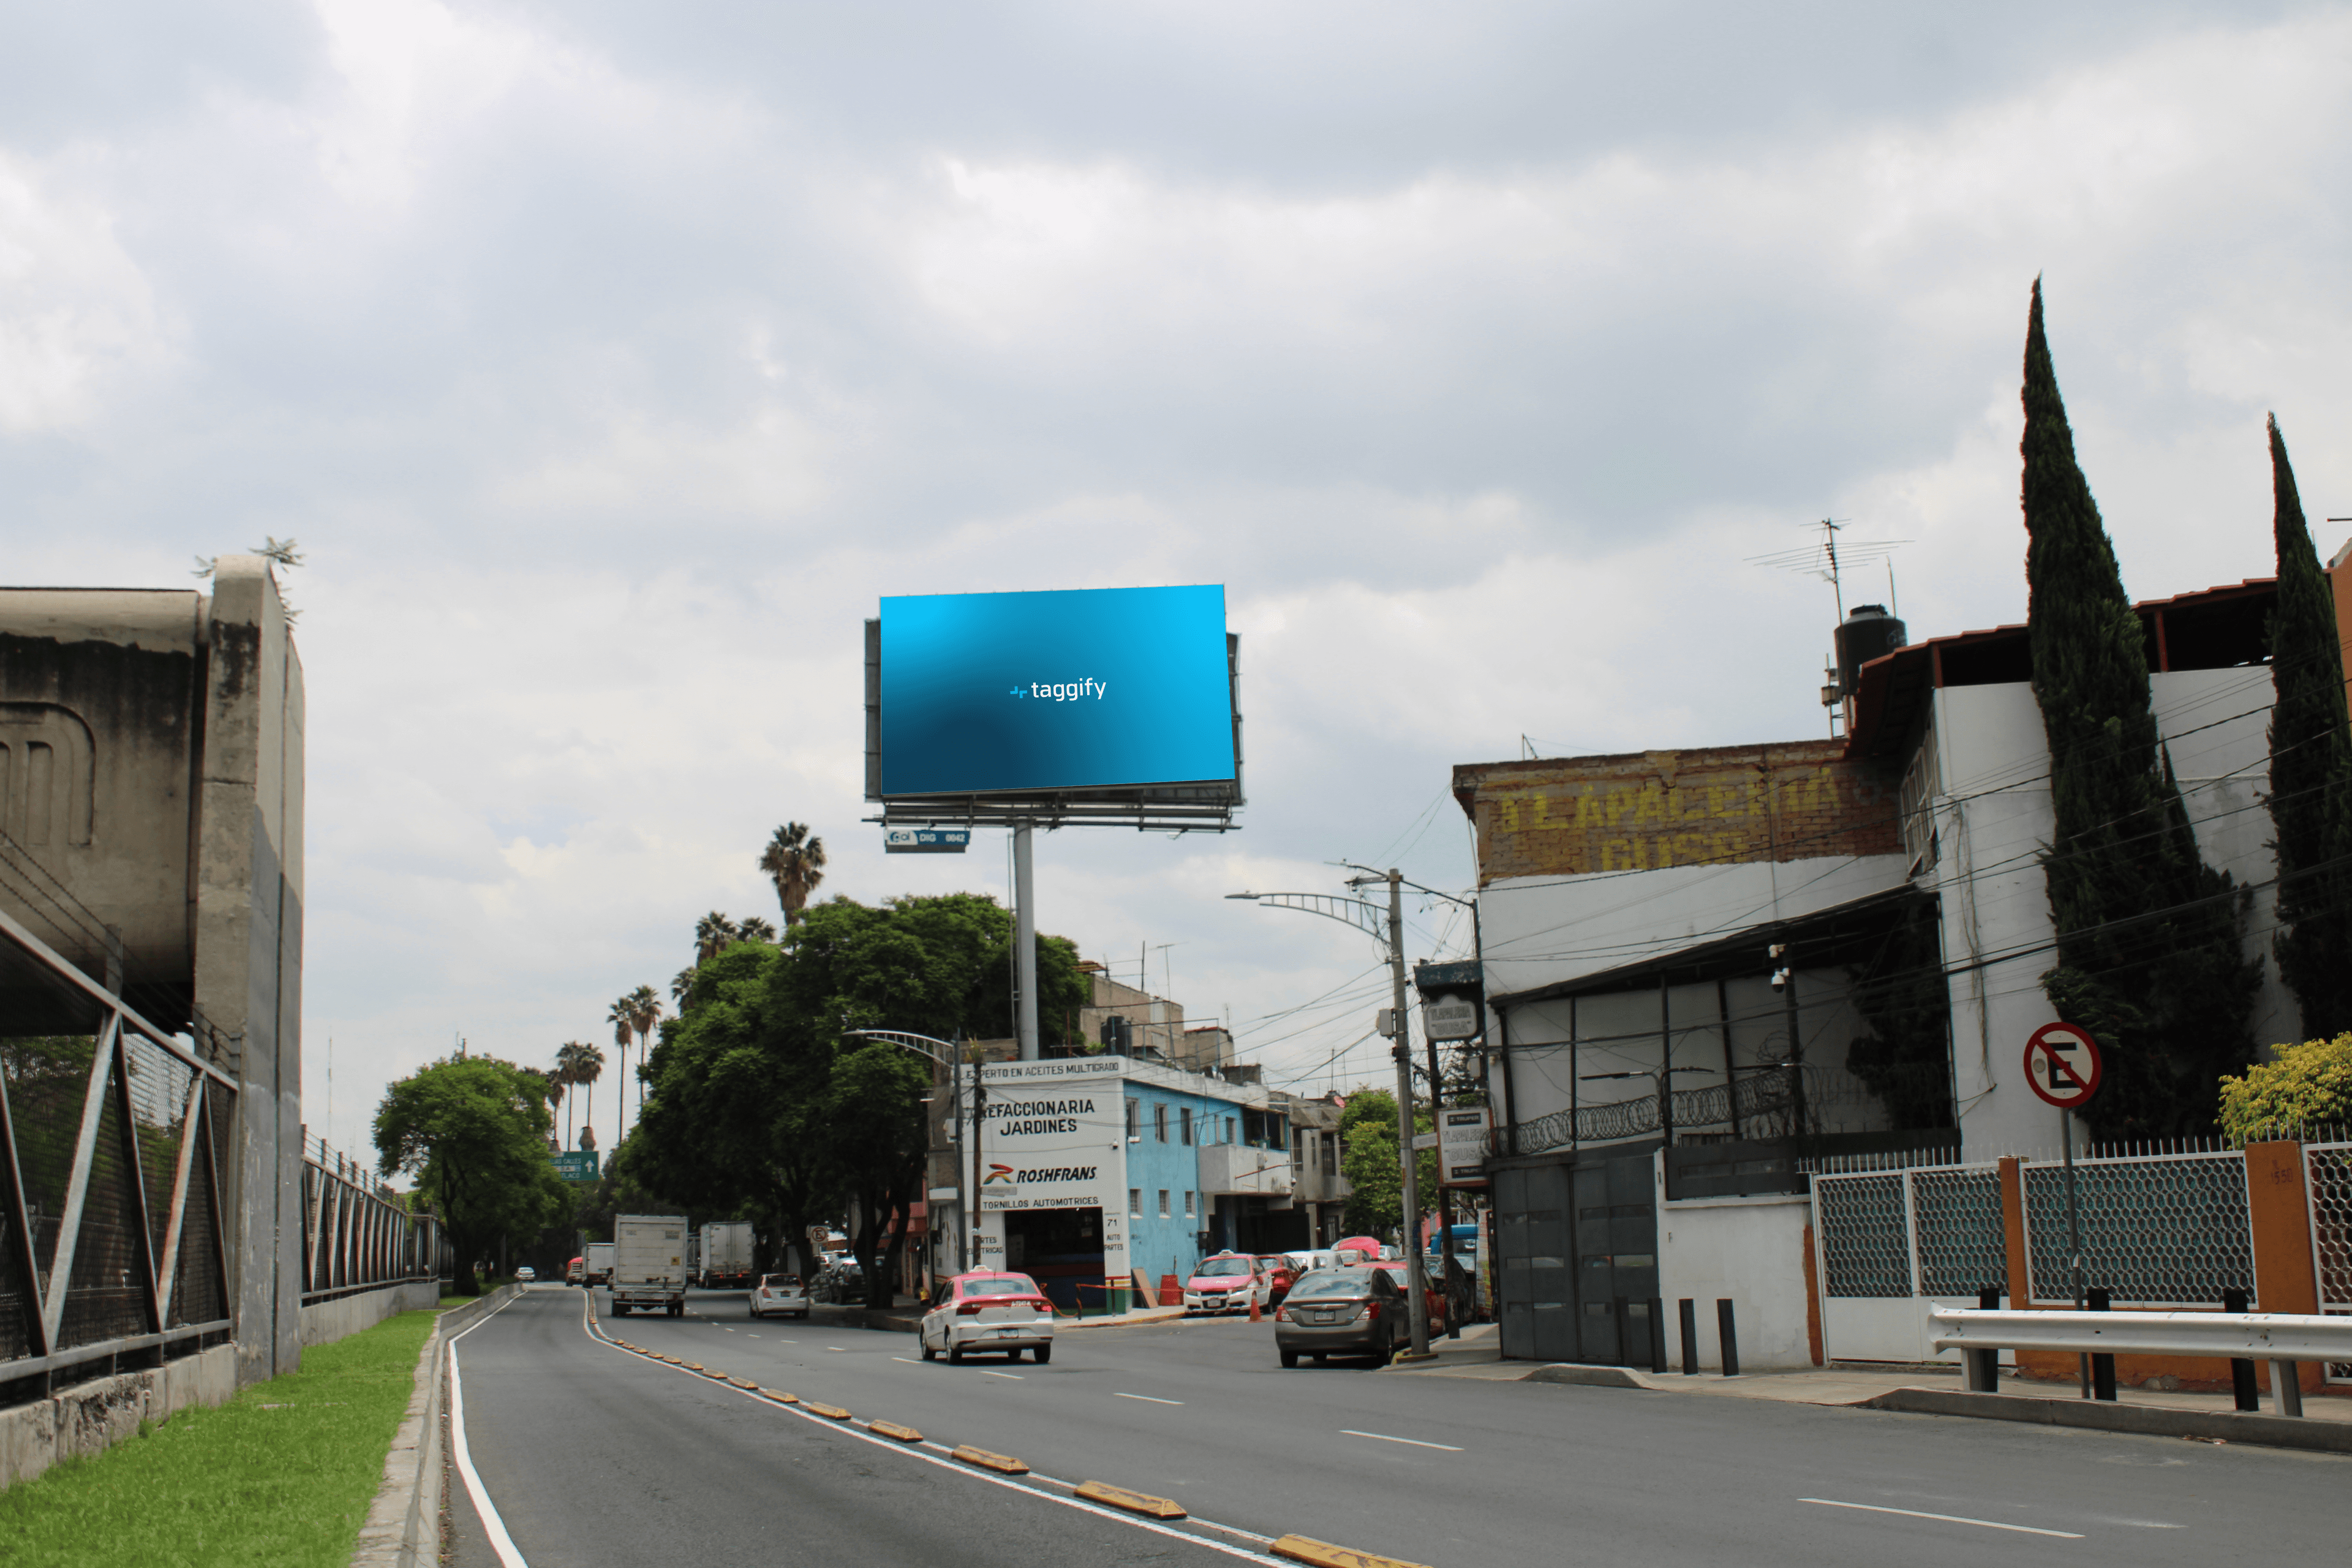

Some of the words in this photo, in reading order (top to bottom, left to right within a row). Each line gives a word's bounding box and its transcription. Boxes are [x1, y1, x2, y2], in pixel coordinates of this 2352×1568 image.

[1031, 677, 1107, 702] taggify
[966, 1068, 1009, 1079] EPERTO
[1011, 1068, 1023, 1077] EN
[1025, 1065, 1064, 1076] ACEITES
[1066, 1062, 1119, 1073] MULTIGRADO
[1000, 1119, 1077, 1136] JARDINES
[1017, 1166, 1098, 1183] ROSHFRANS
[983, 1200, 1029, 1210] TORNILLOS
[1033, 1197, 1099, 1207] AUTOMOTRICES
[1107, 1218, 1117, 1227] 71
